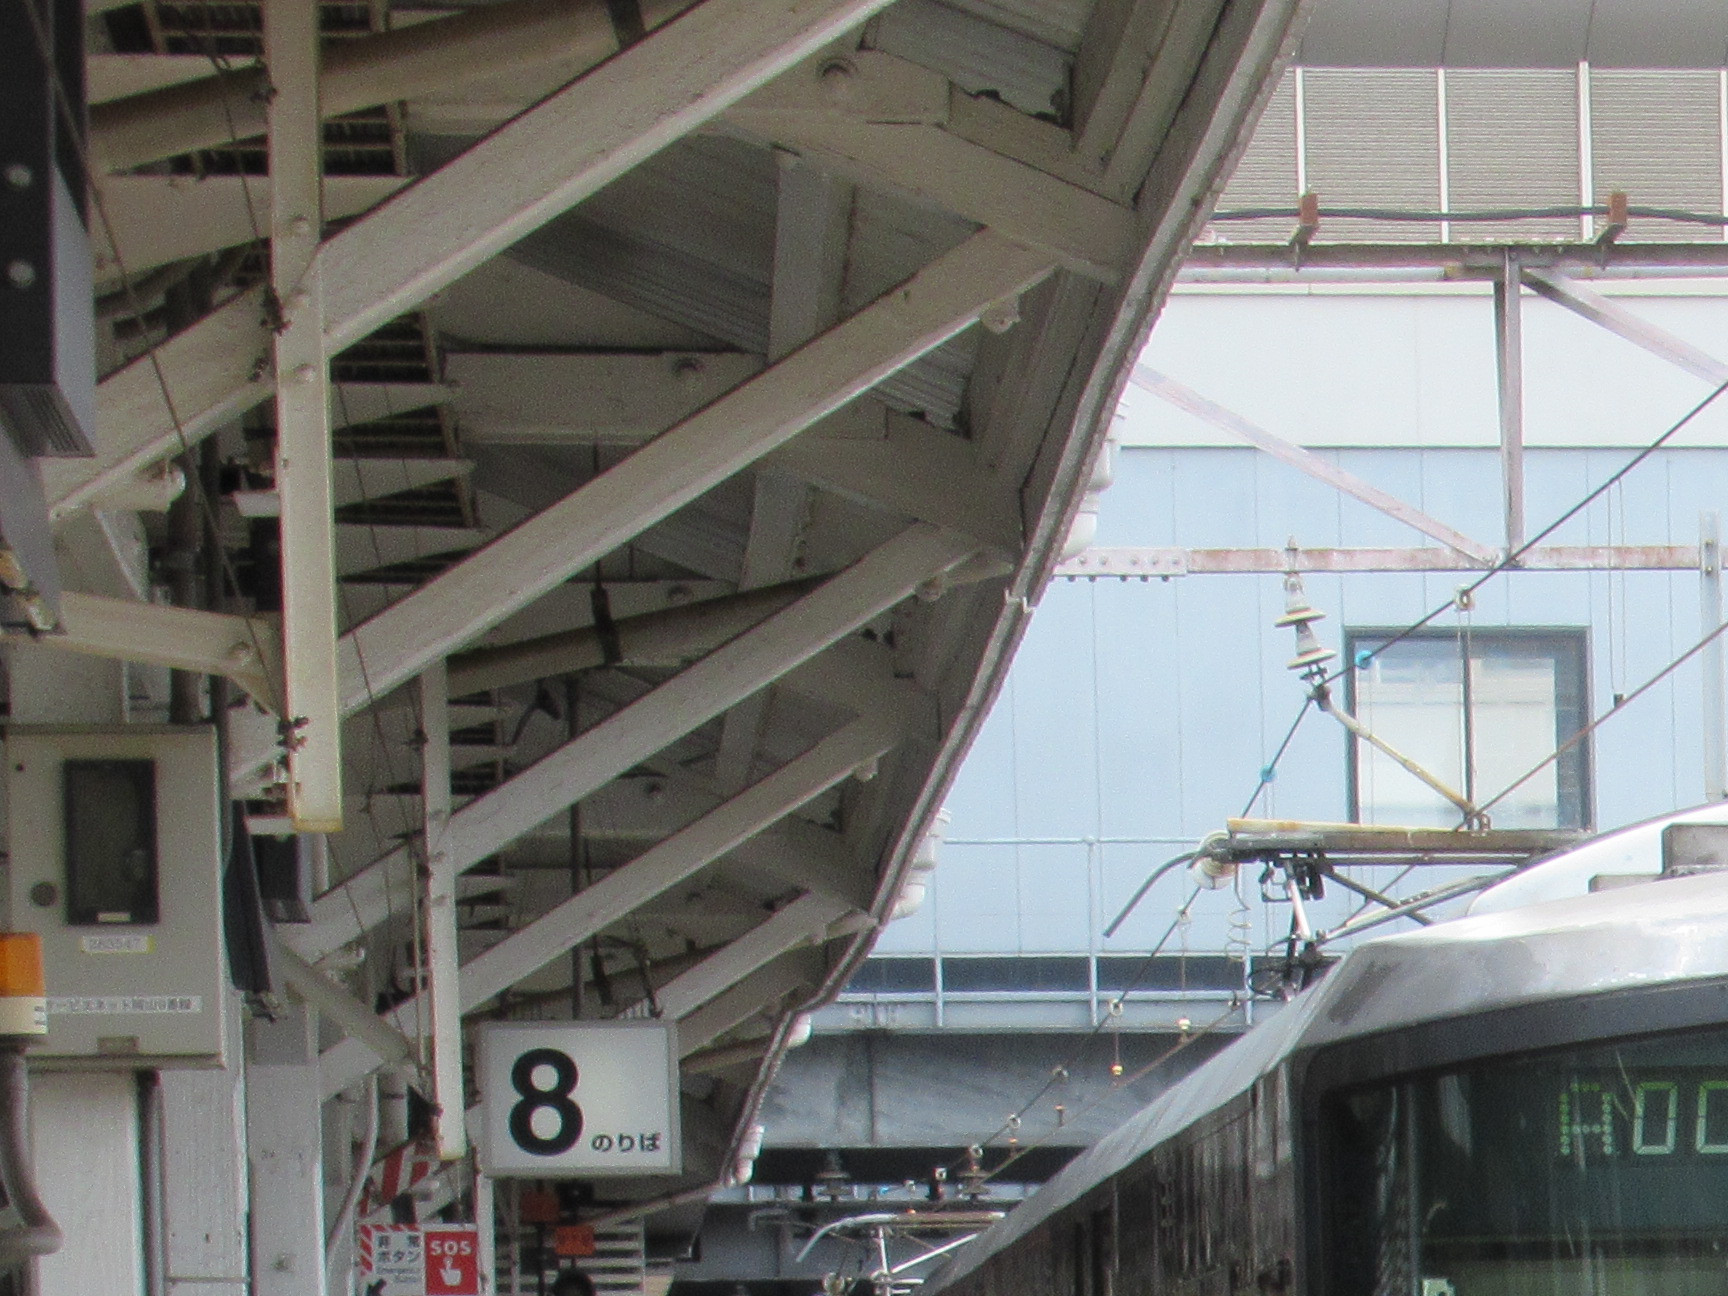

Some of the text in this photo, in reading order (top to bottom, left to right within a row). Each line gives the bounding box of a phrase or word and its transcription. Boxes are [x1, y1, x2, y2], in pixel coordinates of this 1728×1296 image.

[508, 1048, 583, 1155] 8
[590, 1133, 662, 1153] のりば
[430, 1240, 472, 1256] SOS
